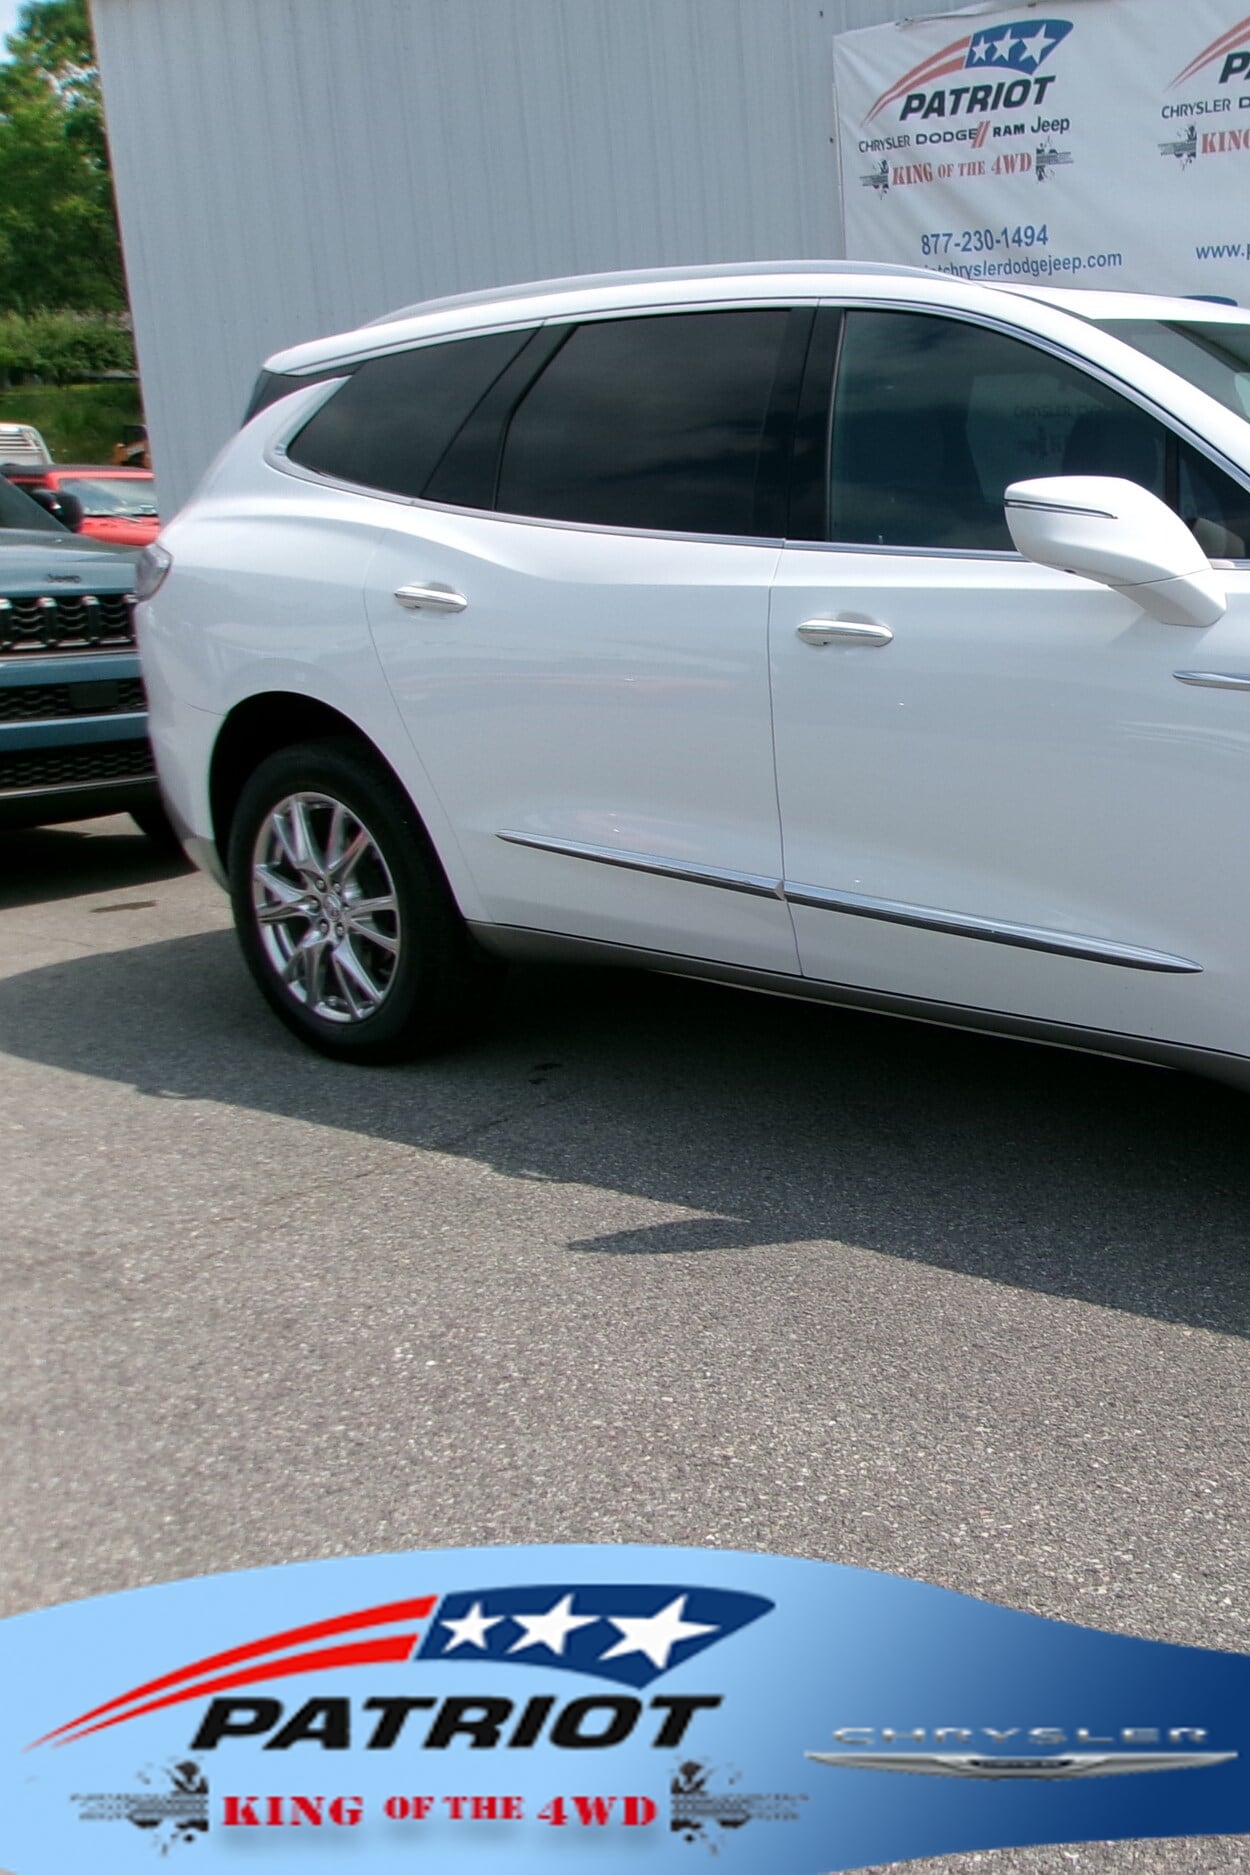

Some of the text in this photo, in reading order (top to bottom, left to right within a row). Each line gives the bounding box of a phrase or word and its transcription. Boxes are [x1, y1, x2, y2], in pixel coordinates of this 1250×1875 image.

[899, 75, 1056, 122] PATRIOT
[1161, 100, 1231, 119] CHRYSLER
[858, 116, 1070, 153] CHRYSLER DODGE RAM Jeep
[892, 152, 1033, 186] KING OF THE 4WD
[920, 224, 1049, 255] 877-230-1494
